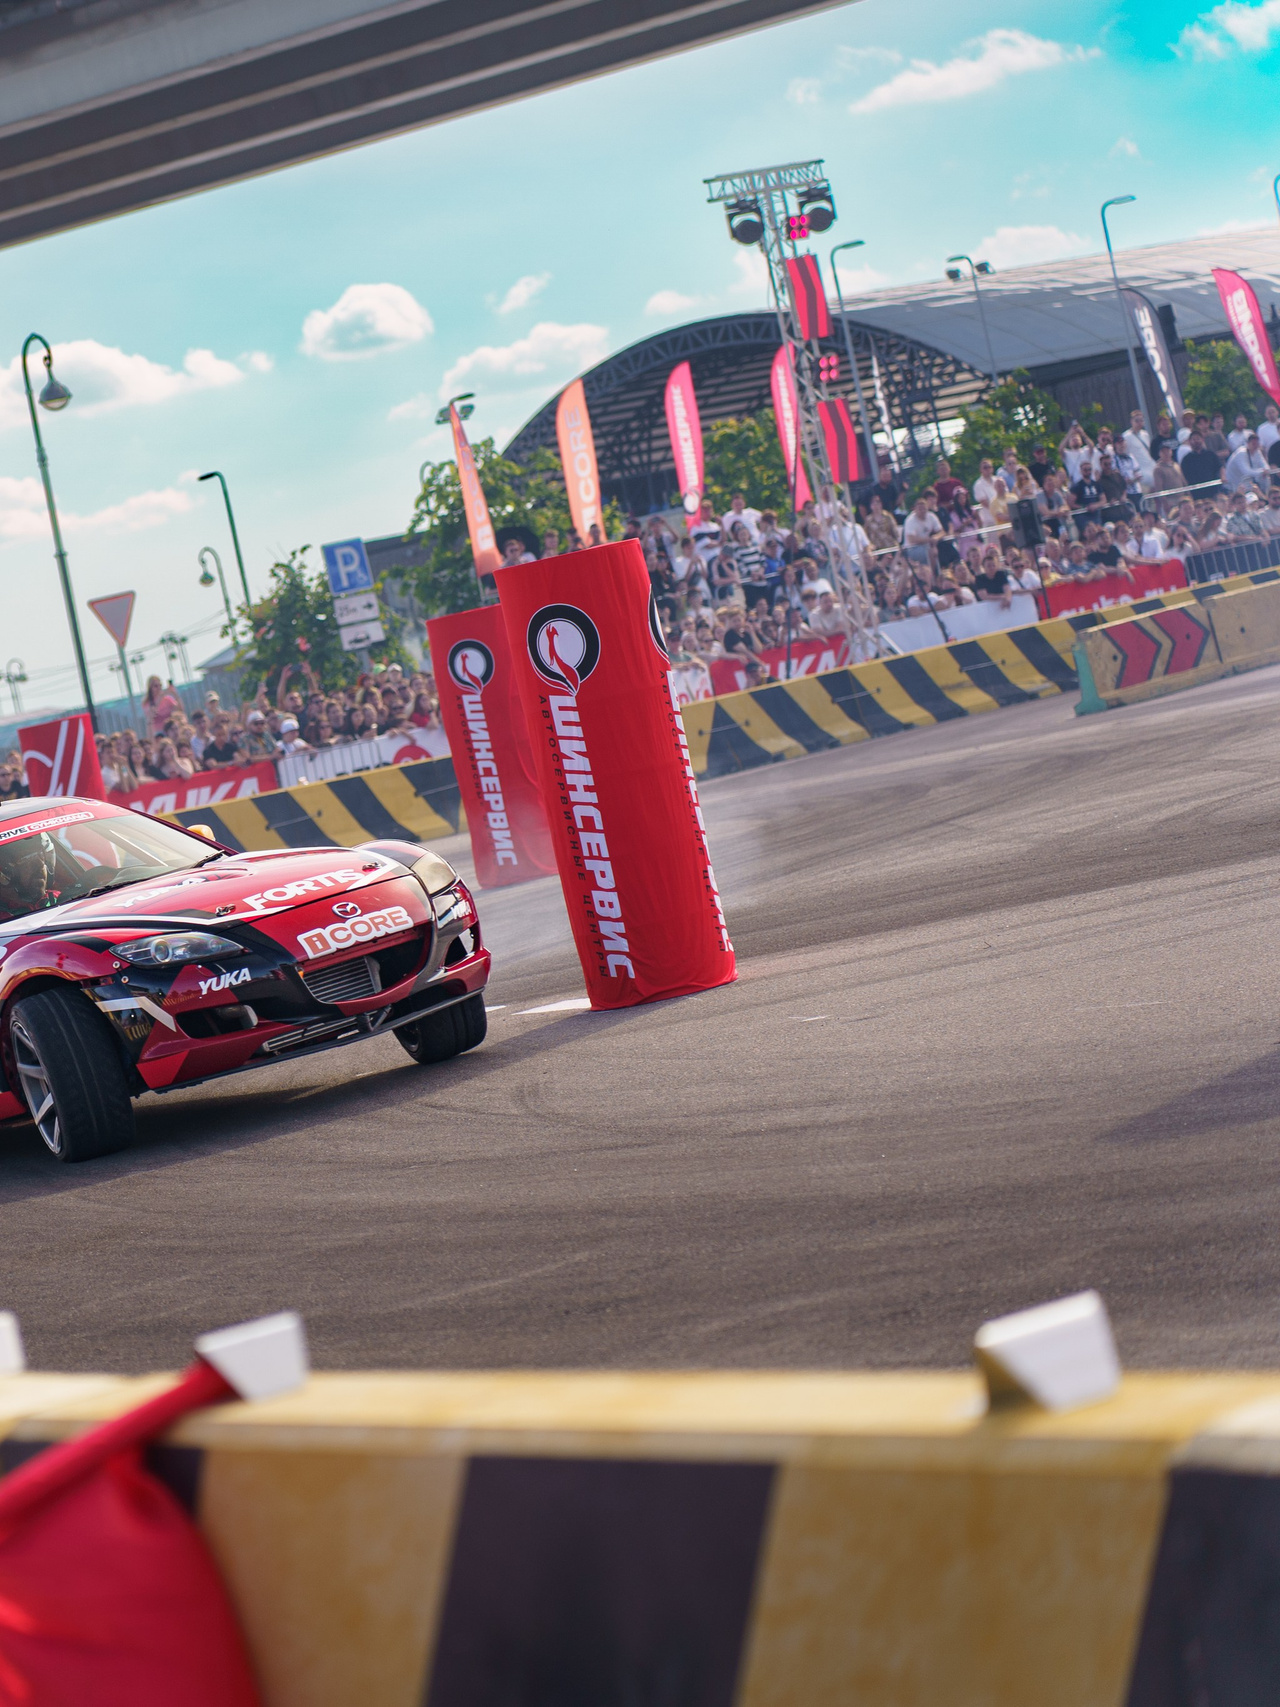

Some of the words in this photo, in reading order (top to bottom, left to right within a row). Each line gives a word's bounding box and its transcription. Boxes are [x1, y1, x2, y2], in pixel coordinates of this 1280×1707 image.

[334, 546, 360, 588] P
[462, 693, 518, 867] ШИНСЕРВИС
[242, 868, 366, 912] FORTIS
[538, 694, 587, 881] АВТОСЕРВИСНЫЕ
[582, 894, 609, 977] ЦЕНТРЫ
[548, 694, 636, 979] ШИНСЕРВИС
[198, 967, 252, 996] YUKA
